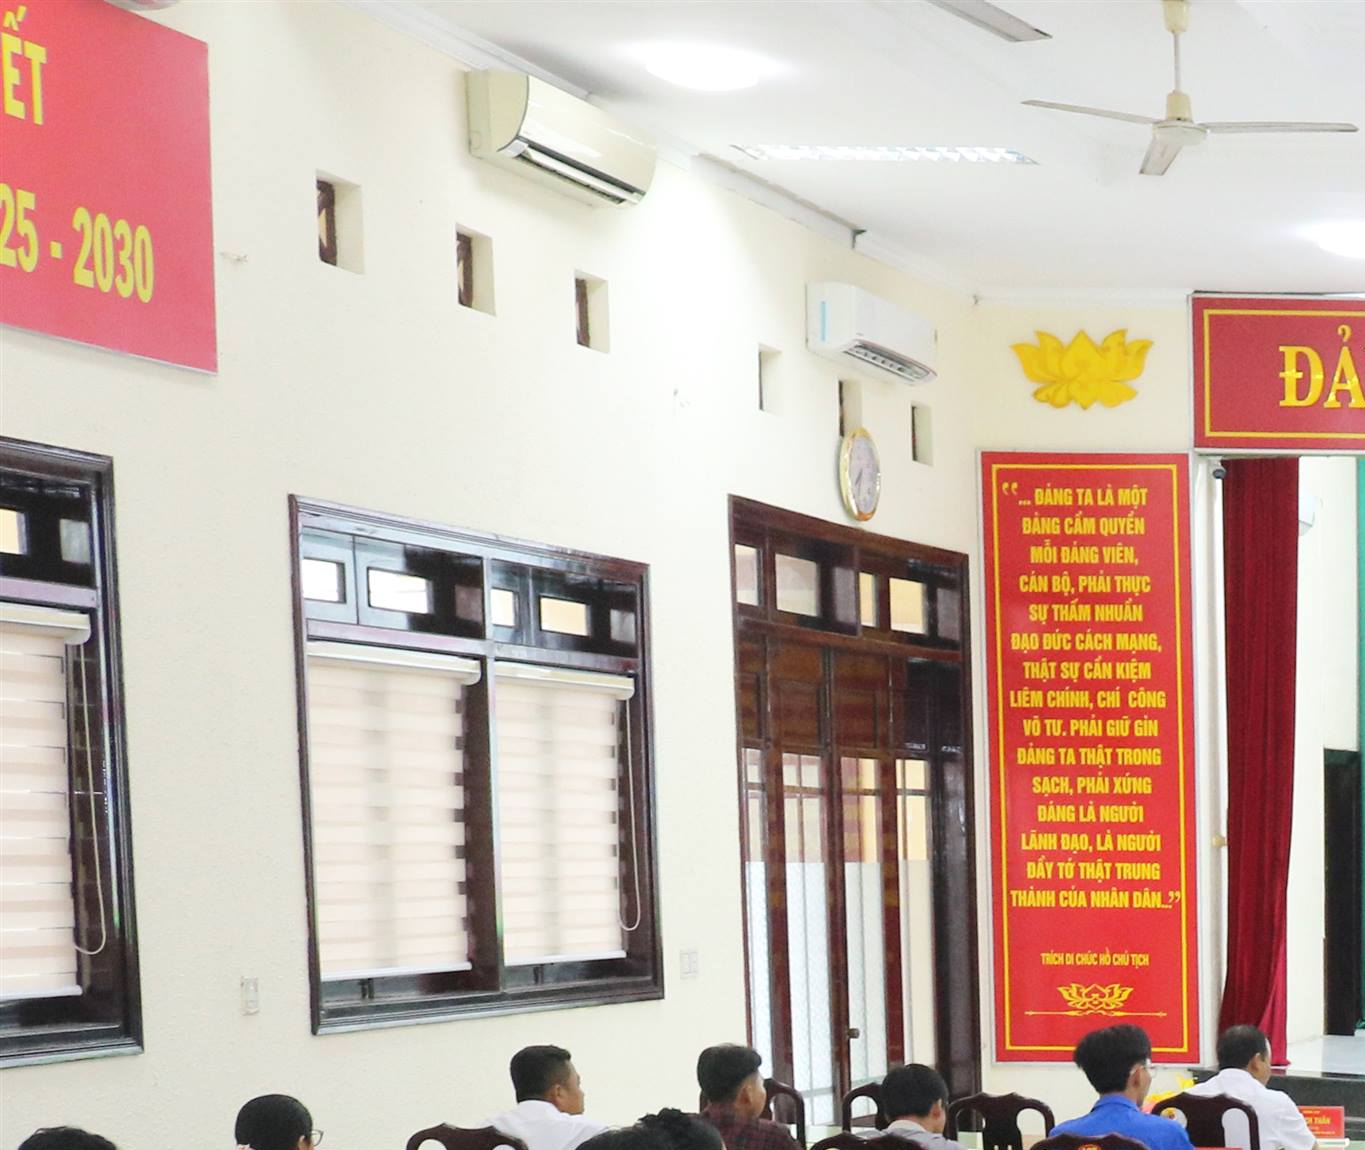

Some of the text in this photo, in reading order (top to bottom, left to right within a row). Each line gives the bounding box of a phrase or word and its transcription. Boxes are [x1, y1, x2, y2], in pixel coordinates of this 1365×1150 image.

[72, 206, 154, 303] 2030
[1076, 488, 1094, 506] TA
[1059, 748, 1076, 765] TA
[1116, 748, 1161, 765] TRONG
[1115, 863, 1160, 880] TRUNG
